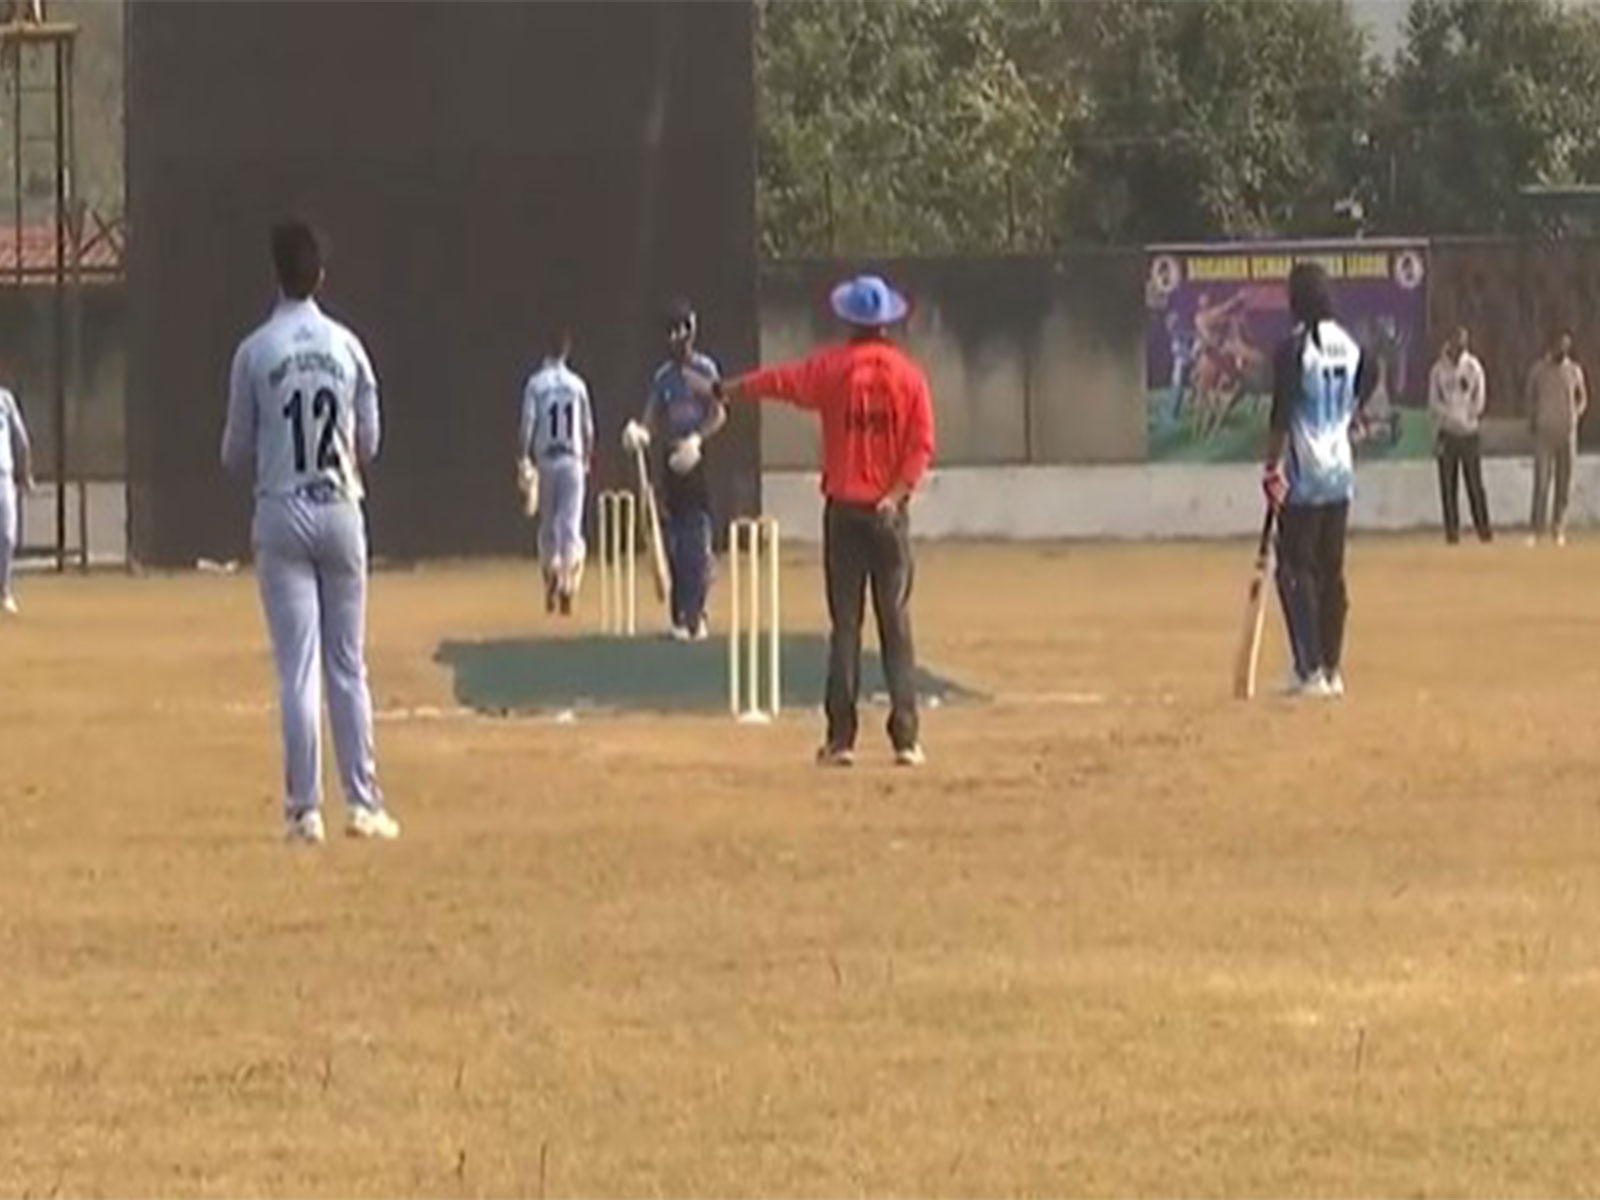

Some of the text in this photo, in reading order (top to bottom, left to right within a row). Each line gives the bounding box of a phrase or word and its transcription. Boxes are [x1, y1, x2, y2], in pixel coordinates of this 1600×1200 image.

[549, 401, 574, 439] 11
[1322, 365, 1348, 421] 17
[283, 387, 340, 473] 12
